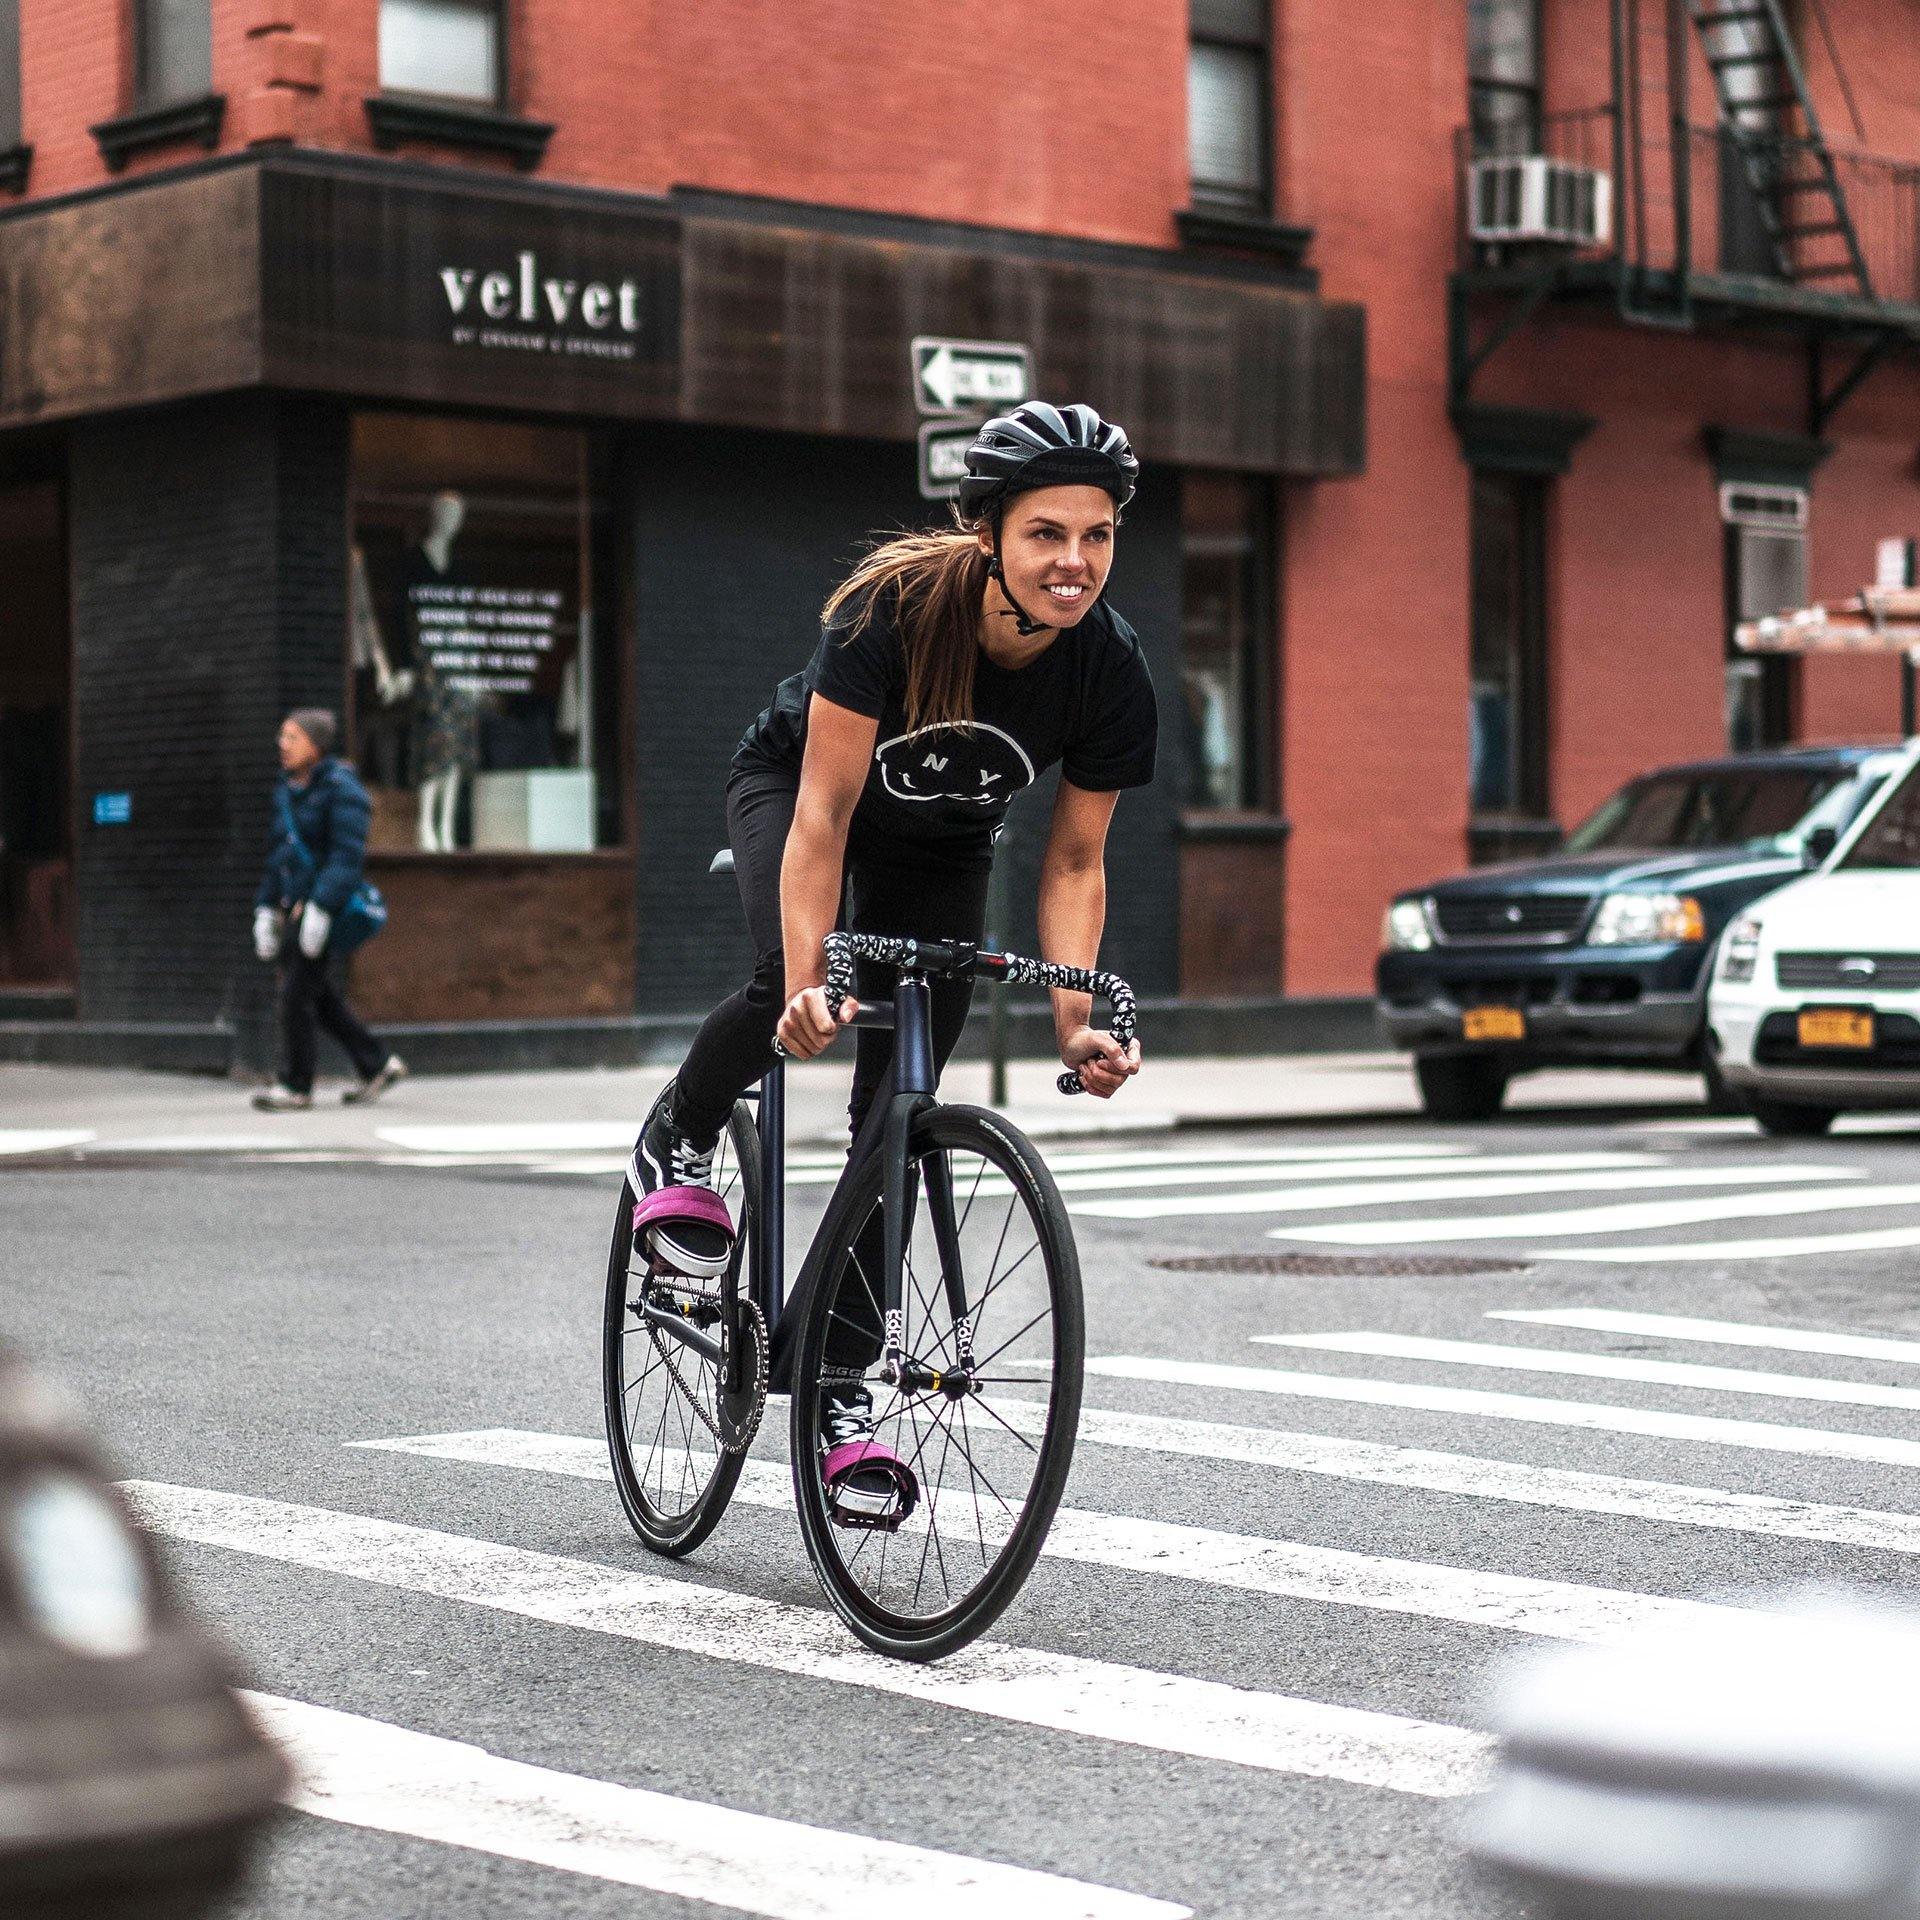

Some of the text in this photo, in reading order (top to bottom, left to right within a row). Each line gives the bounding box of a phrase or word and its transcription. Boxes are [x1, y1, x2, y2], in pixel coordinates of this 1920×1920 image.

[440, 251, 639, 331] velvet
[921, 753, 1001, 786] N Y
